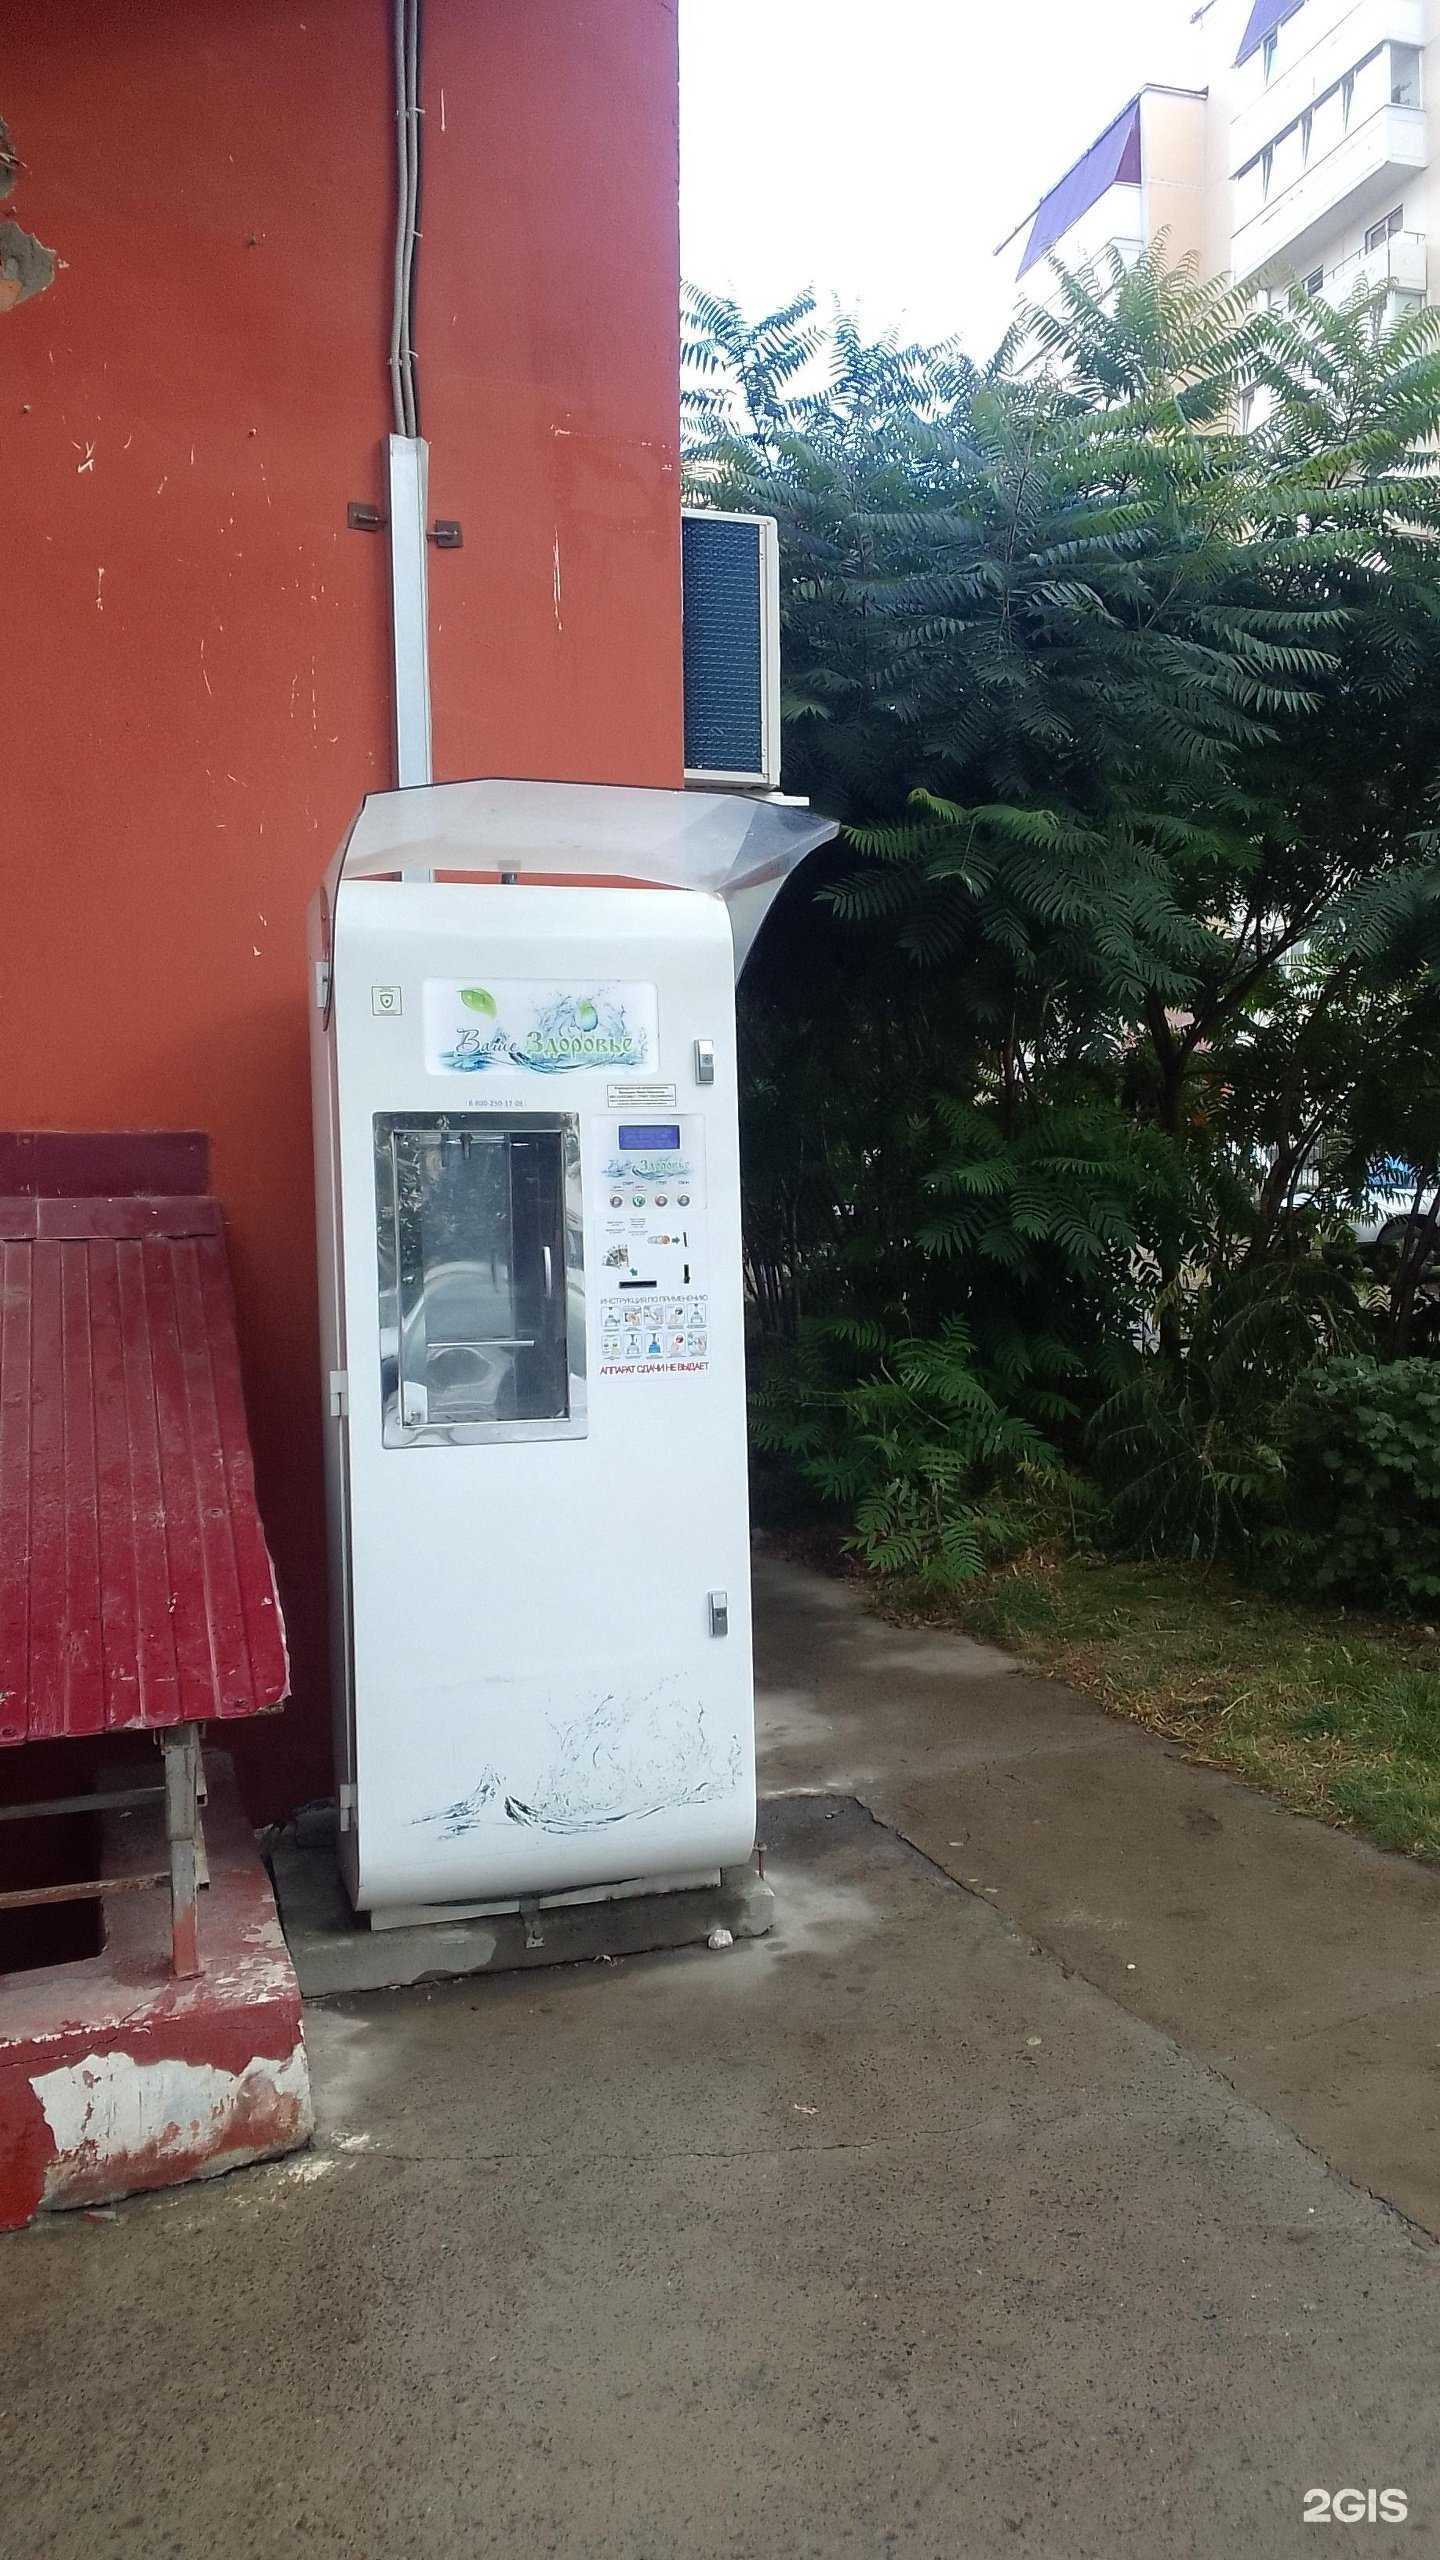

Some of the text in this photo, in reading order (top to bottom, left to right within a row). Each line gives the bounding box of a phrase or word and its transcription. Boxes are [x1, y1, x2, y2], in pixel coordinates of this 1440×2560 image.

[456, 1029, 633, 1056] Ваше Здоровье
[600, 1362, 709, 1375] АППАРАТ СДАЧИ НЕ ВЫДАЕТ
